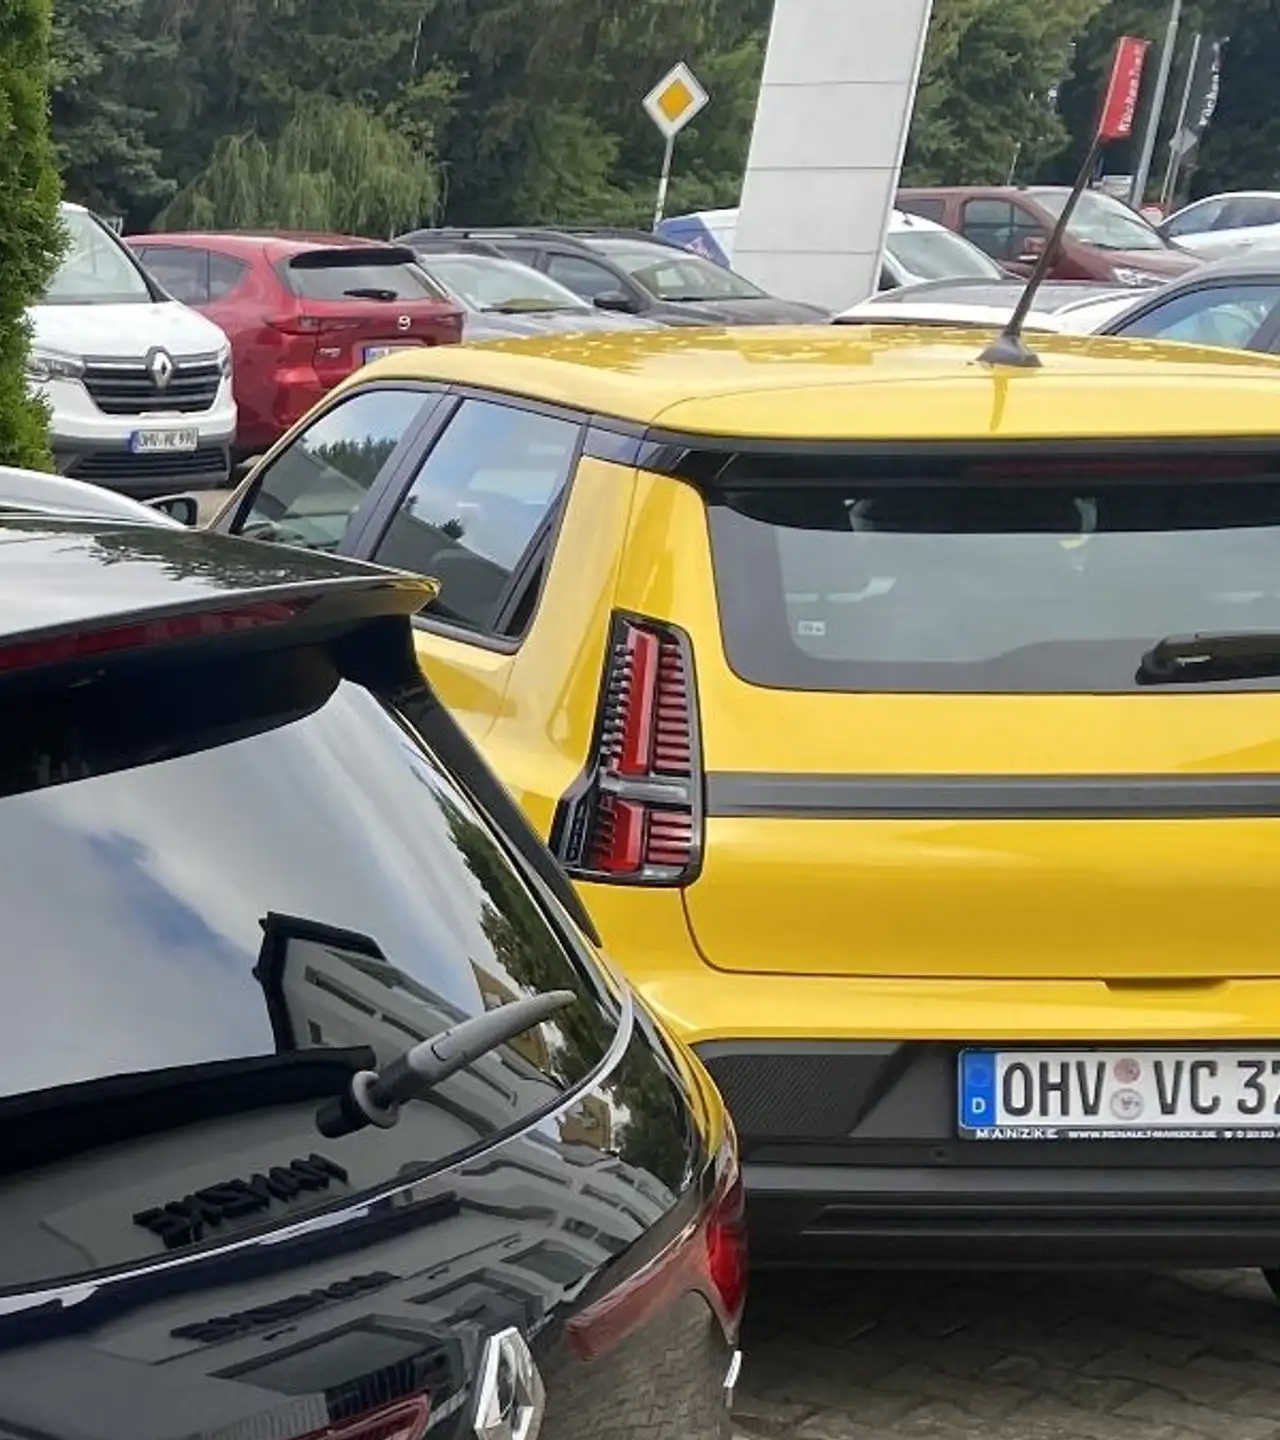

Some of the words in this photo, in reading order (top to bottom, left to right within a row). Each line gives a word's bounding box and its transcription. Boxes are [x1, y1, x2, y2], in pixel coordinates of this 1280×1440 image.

[1002, 1060, 1107, 1118] OHV
[1153, 1060, 1222, 1116] VC
[971, 1097, 986, 1113] D
[976, 1128, 1059, 1140] MANZKE
